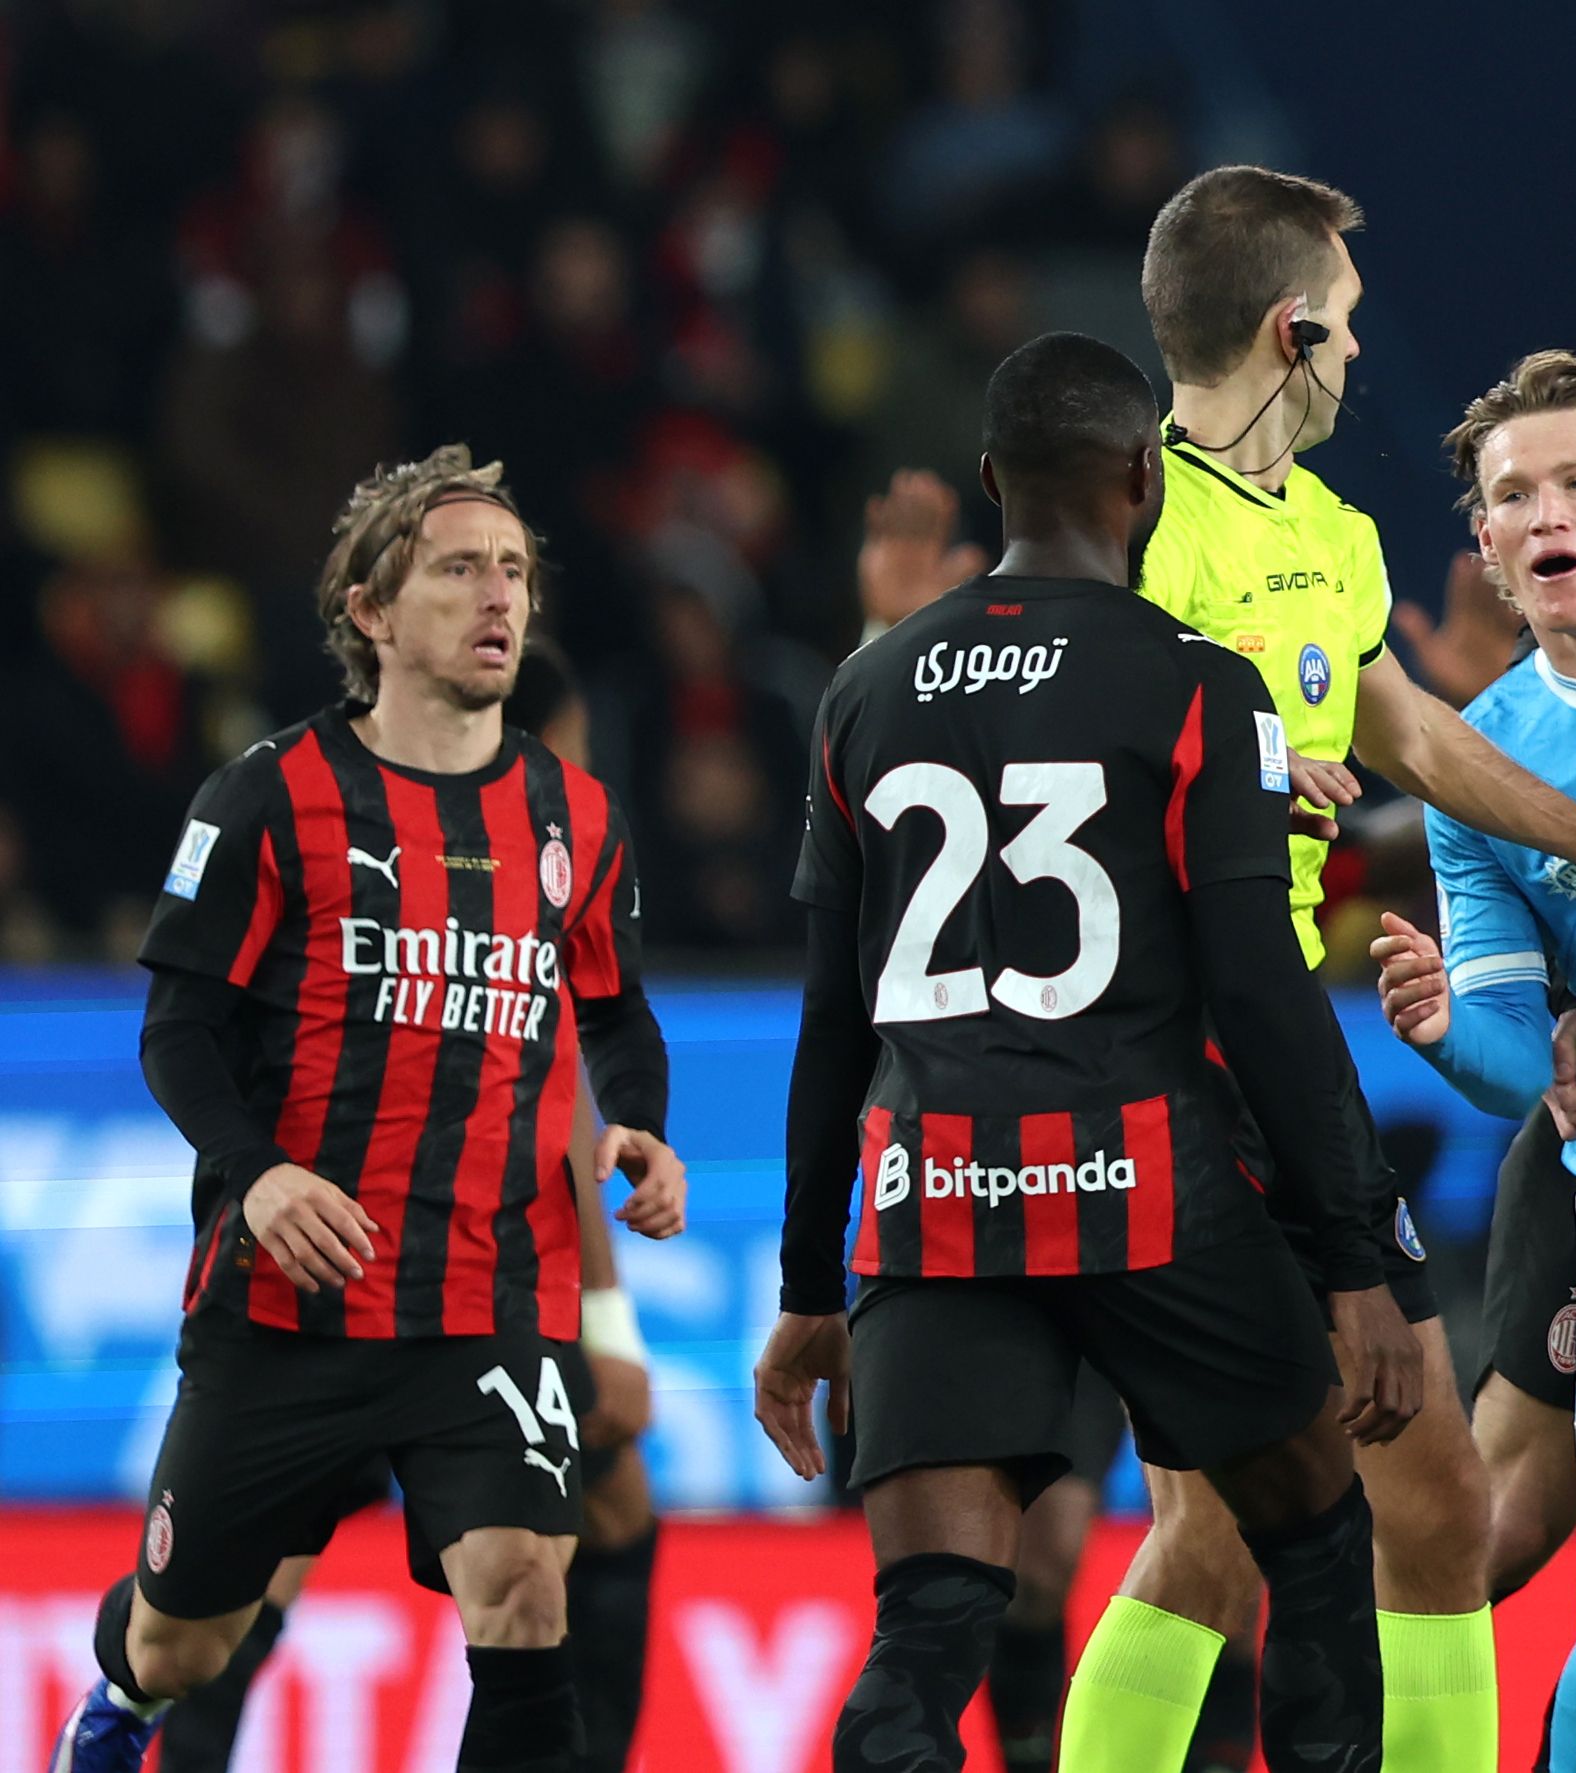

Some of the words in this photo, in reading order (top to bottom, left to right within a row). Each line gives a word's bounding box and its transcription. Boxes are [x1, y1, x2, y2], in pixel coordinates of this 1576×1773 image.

[914, 637, 1069, 702] توموري
[864, 762, 1120, 1023] 23
[339, 917, 560, 992] Emirate
[374, 977, 434, 1025] FLY
[441, 982, 548, 1042] BETTER
[924, 1149, 1136, 1208] bitpanda
[476, 1356, 580, 1452] 14
